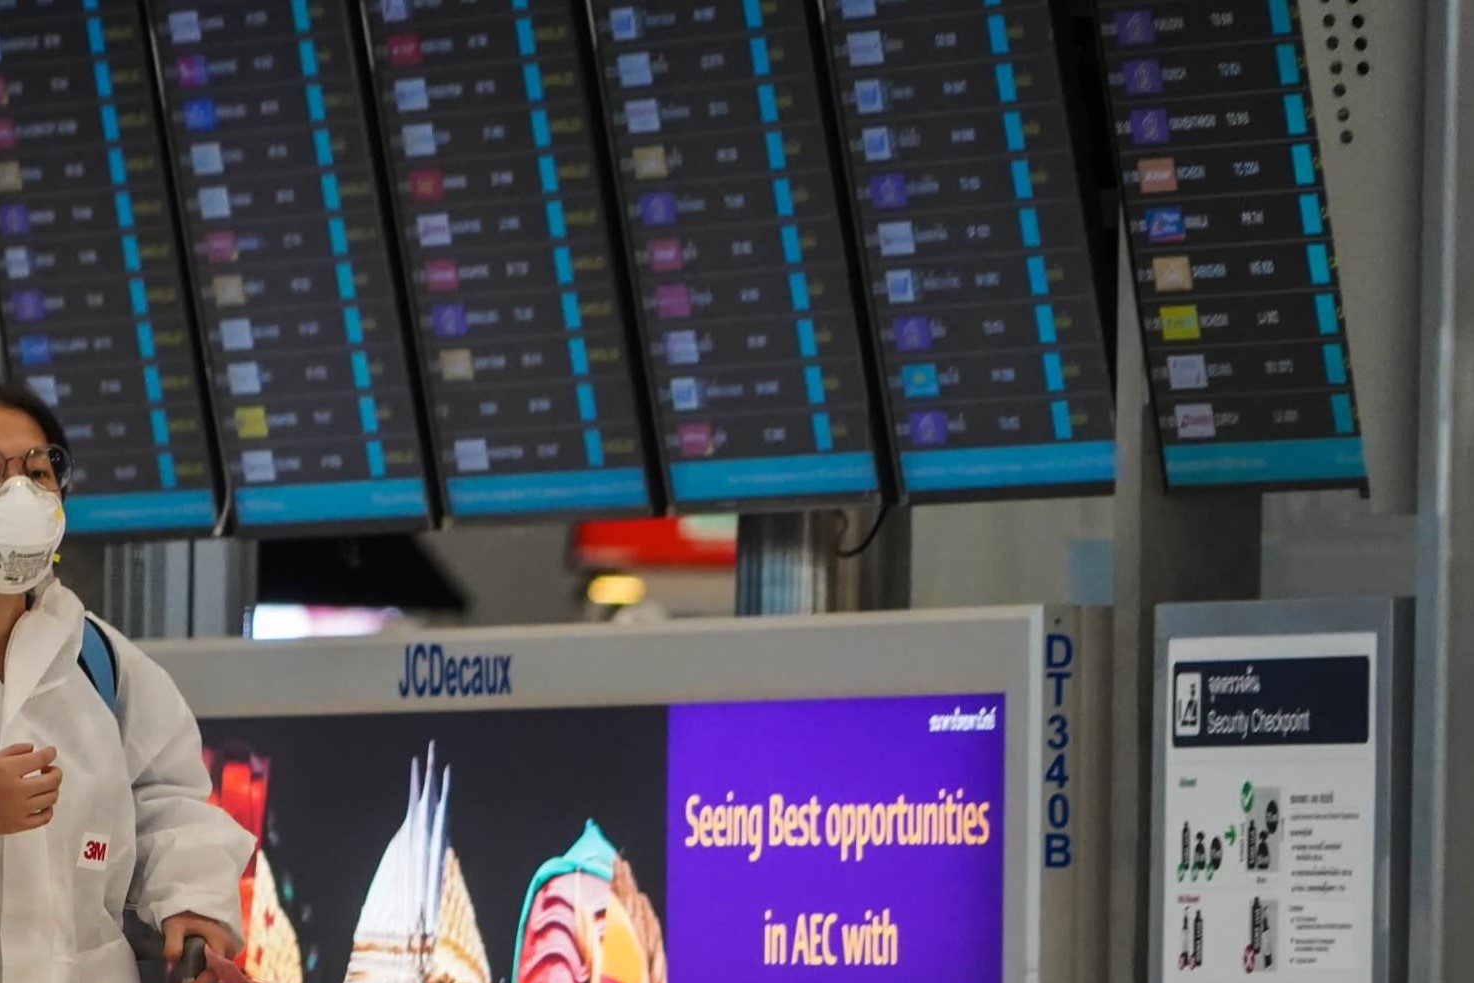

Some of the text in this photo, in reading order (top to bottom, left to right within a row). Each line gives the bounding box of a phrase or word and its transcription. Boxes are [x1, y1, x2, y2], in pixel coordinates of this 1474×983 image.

[398, 643, 512, 698] JCDecaux
[1207, 707, 1311, 739] Security Checkpoint
[84, 840, 108, 861] 3M
[684, 788, 991, 862] Seeing Best opportunities
[764, 908, 899, 967] in AEC with
